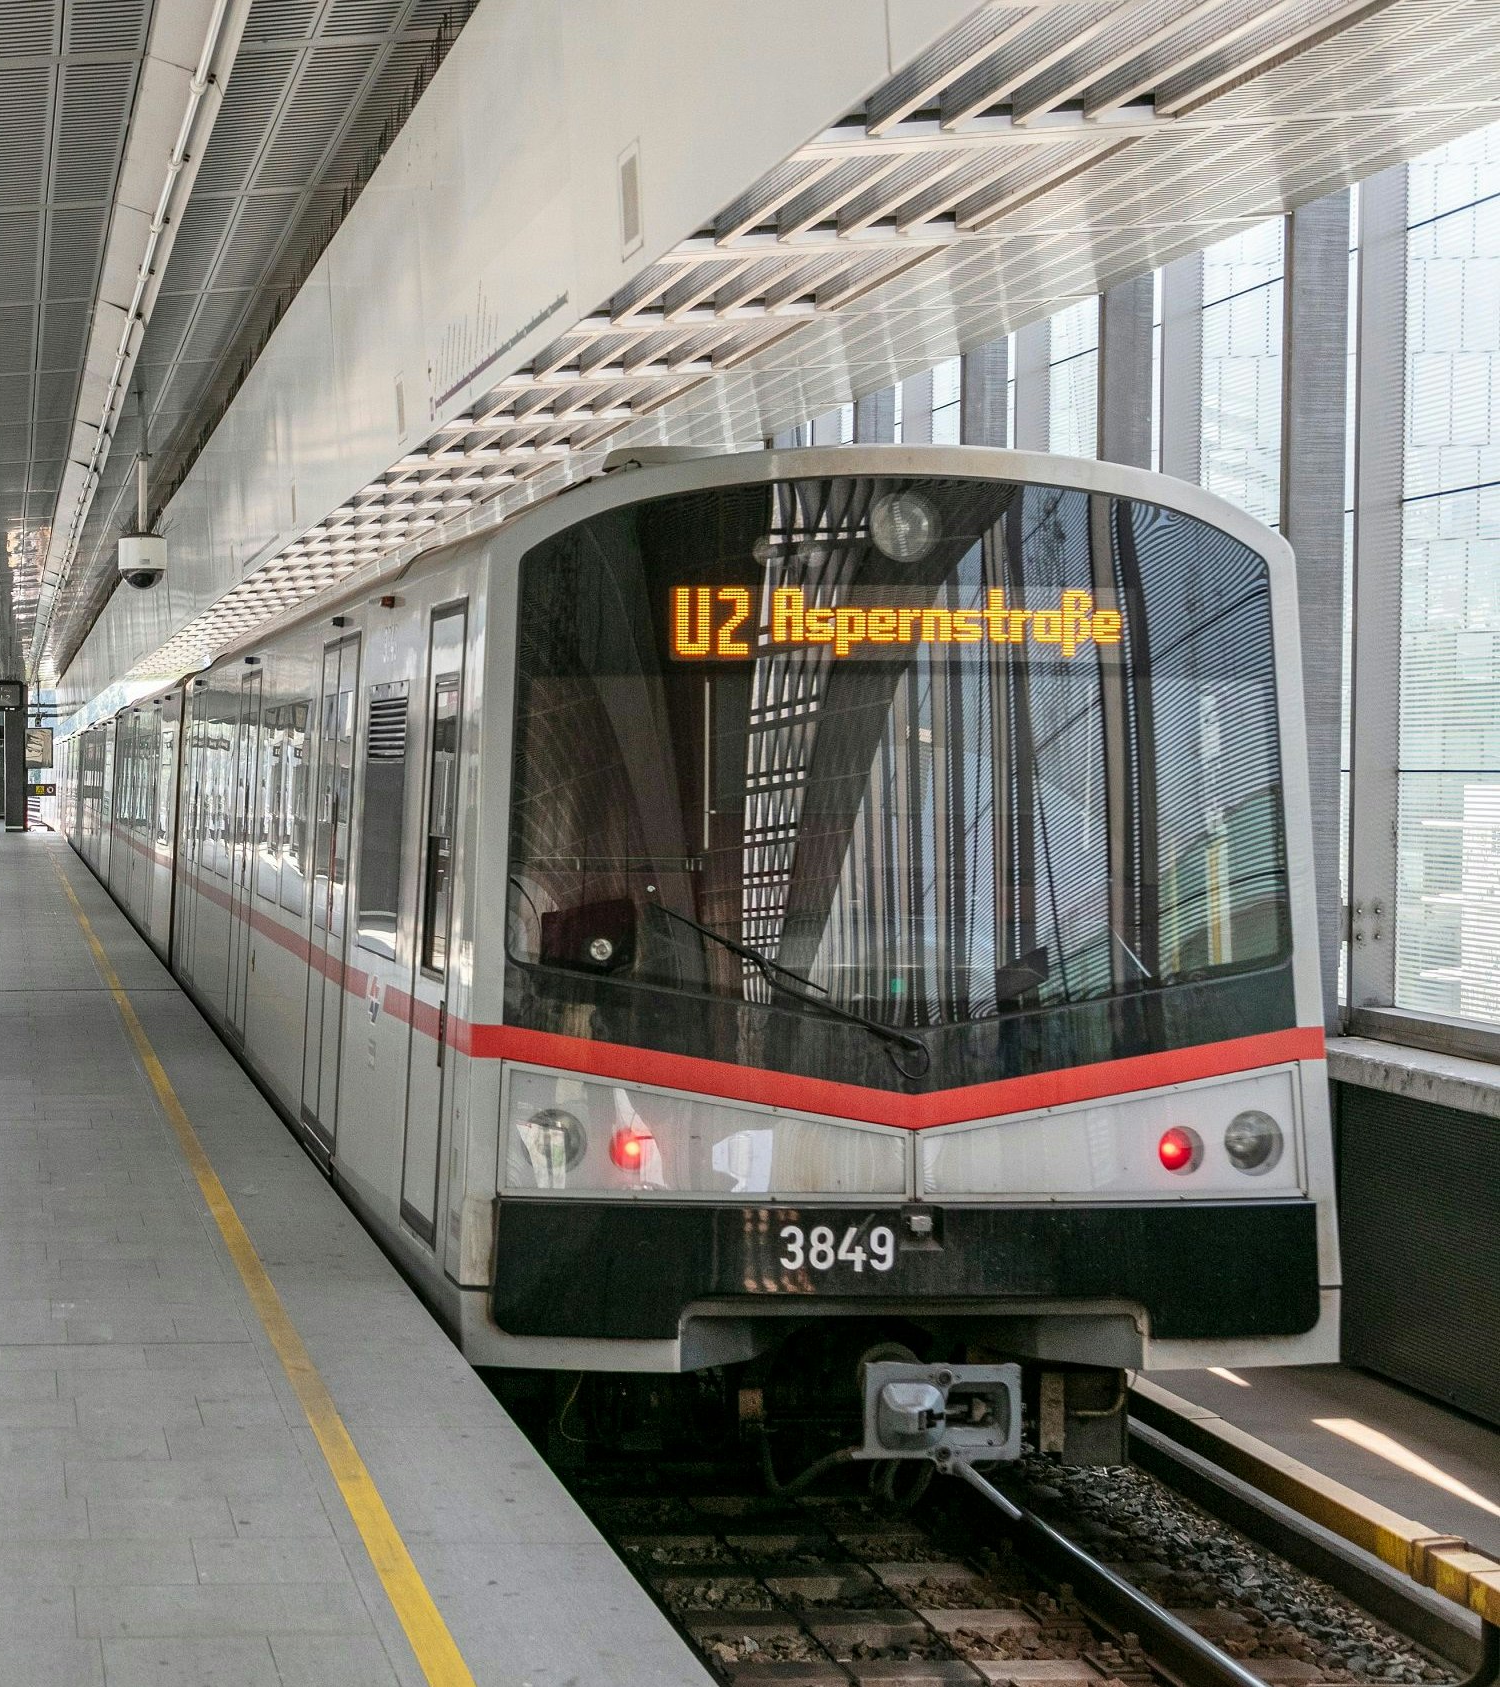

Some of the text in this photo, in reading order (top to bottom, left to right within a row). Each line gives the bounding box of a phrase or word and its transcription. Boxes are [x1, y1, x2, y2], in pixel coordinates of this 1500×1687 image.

[676, 588, 1121, 657] U2 Aspernstraße
[780, 1225, 894, 1272] 3849
